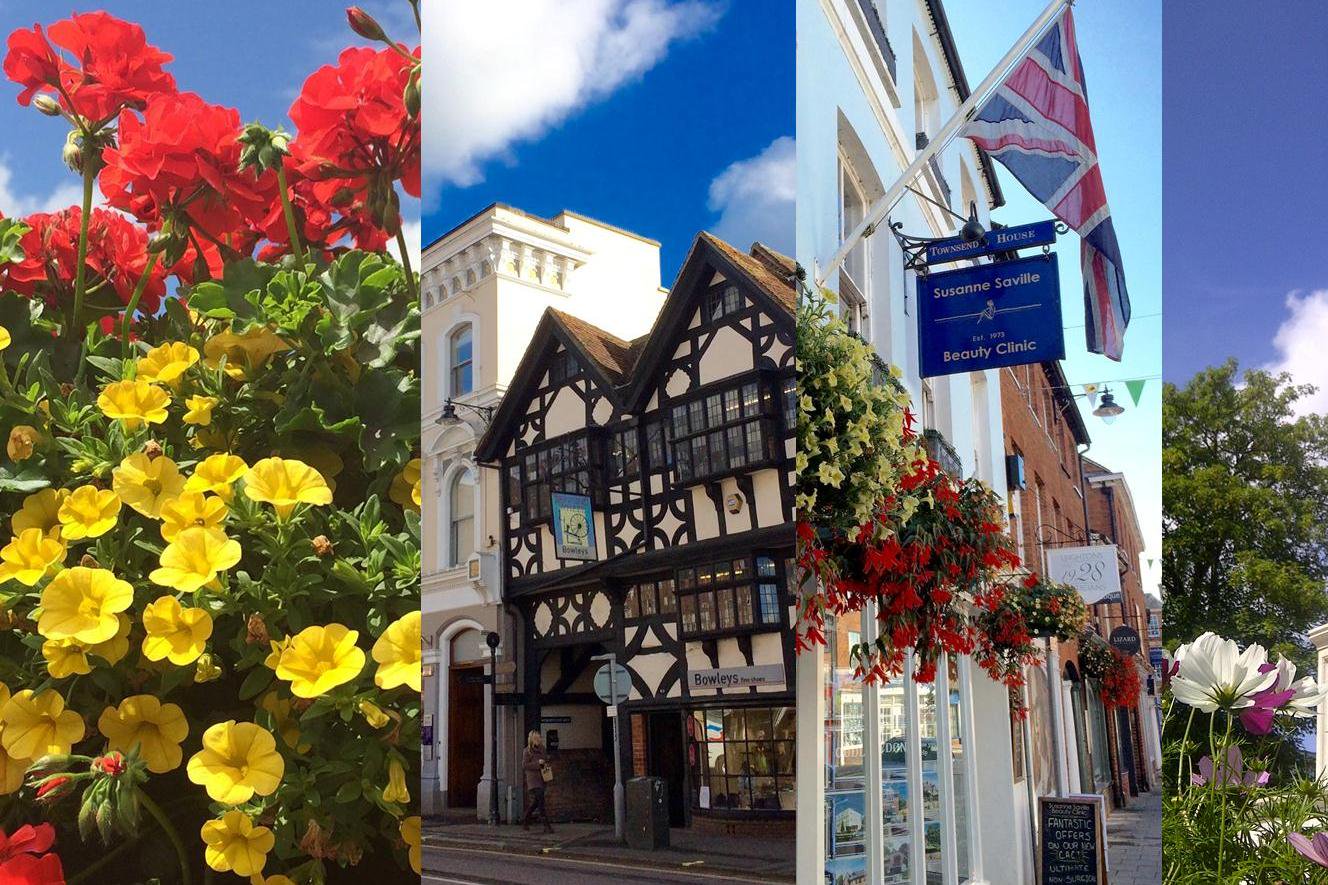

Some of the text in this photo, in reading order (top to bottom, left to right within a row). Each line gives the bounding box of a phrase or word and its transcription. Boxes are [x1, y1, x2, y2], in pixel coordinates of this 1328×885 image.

[929, 230, 1036, 256] TOWNSEND HOUSE
[933, 272, 1041, 299] Susanne Saville
[972, 331, 1006, 342] Est. 1973
[943, 340, 1037, 362] Beauty Clinic
[1063, 560, 1106, 582] 1928
[694, 672, 739, 687] Bowleys
[1048, 817, 1093, 830] FANTASTIC
[1055, 830, 1091, 841] OFFERS
[1062, 841, 1079, 850] OUR
